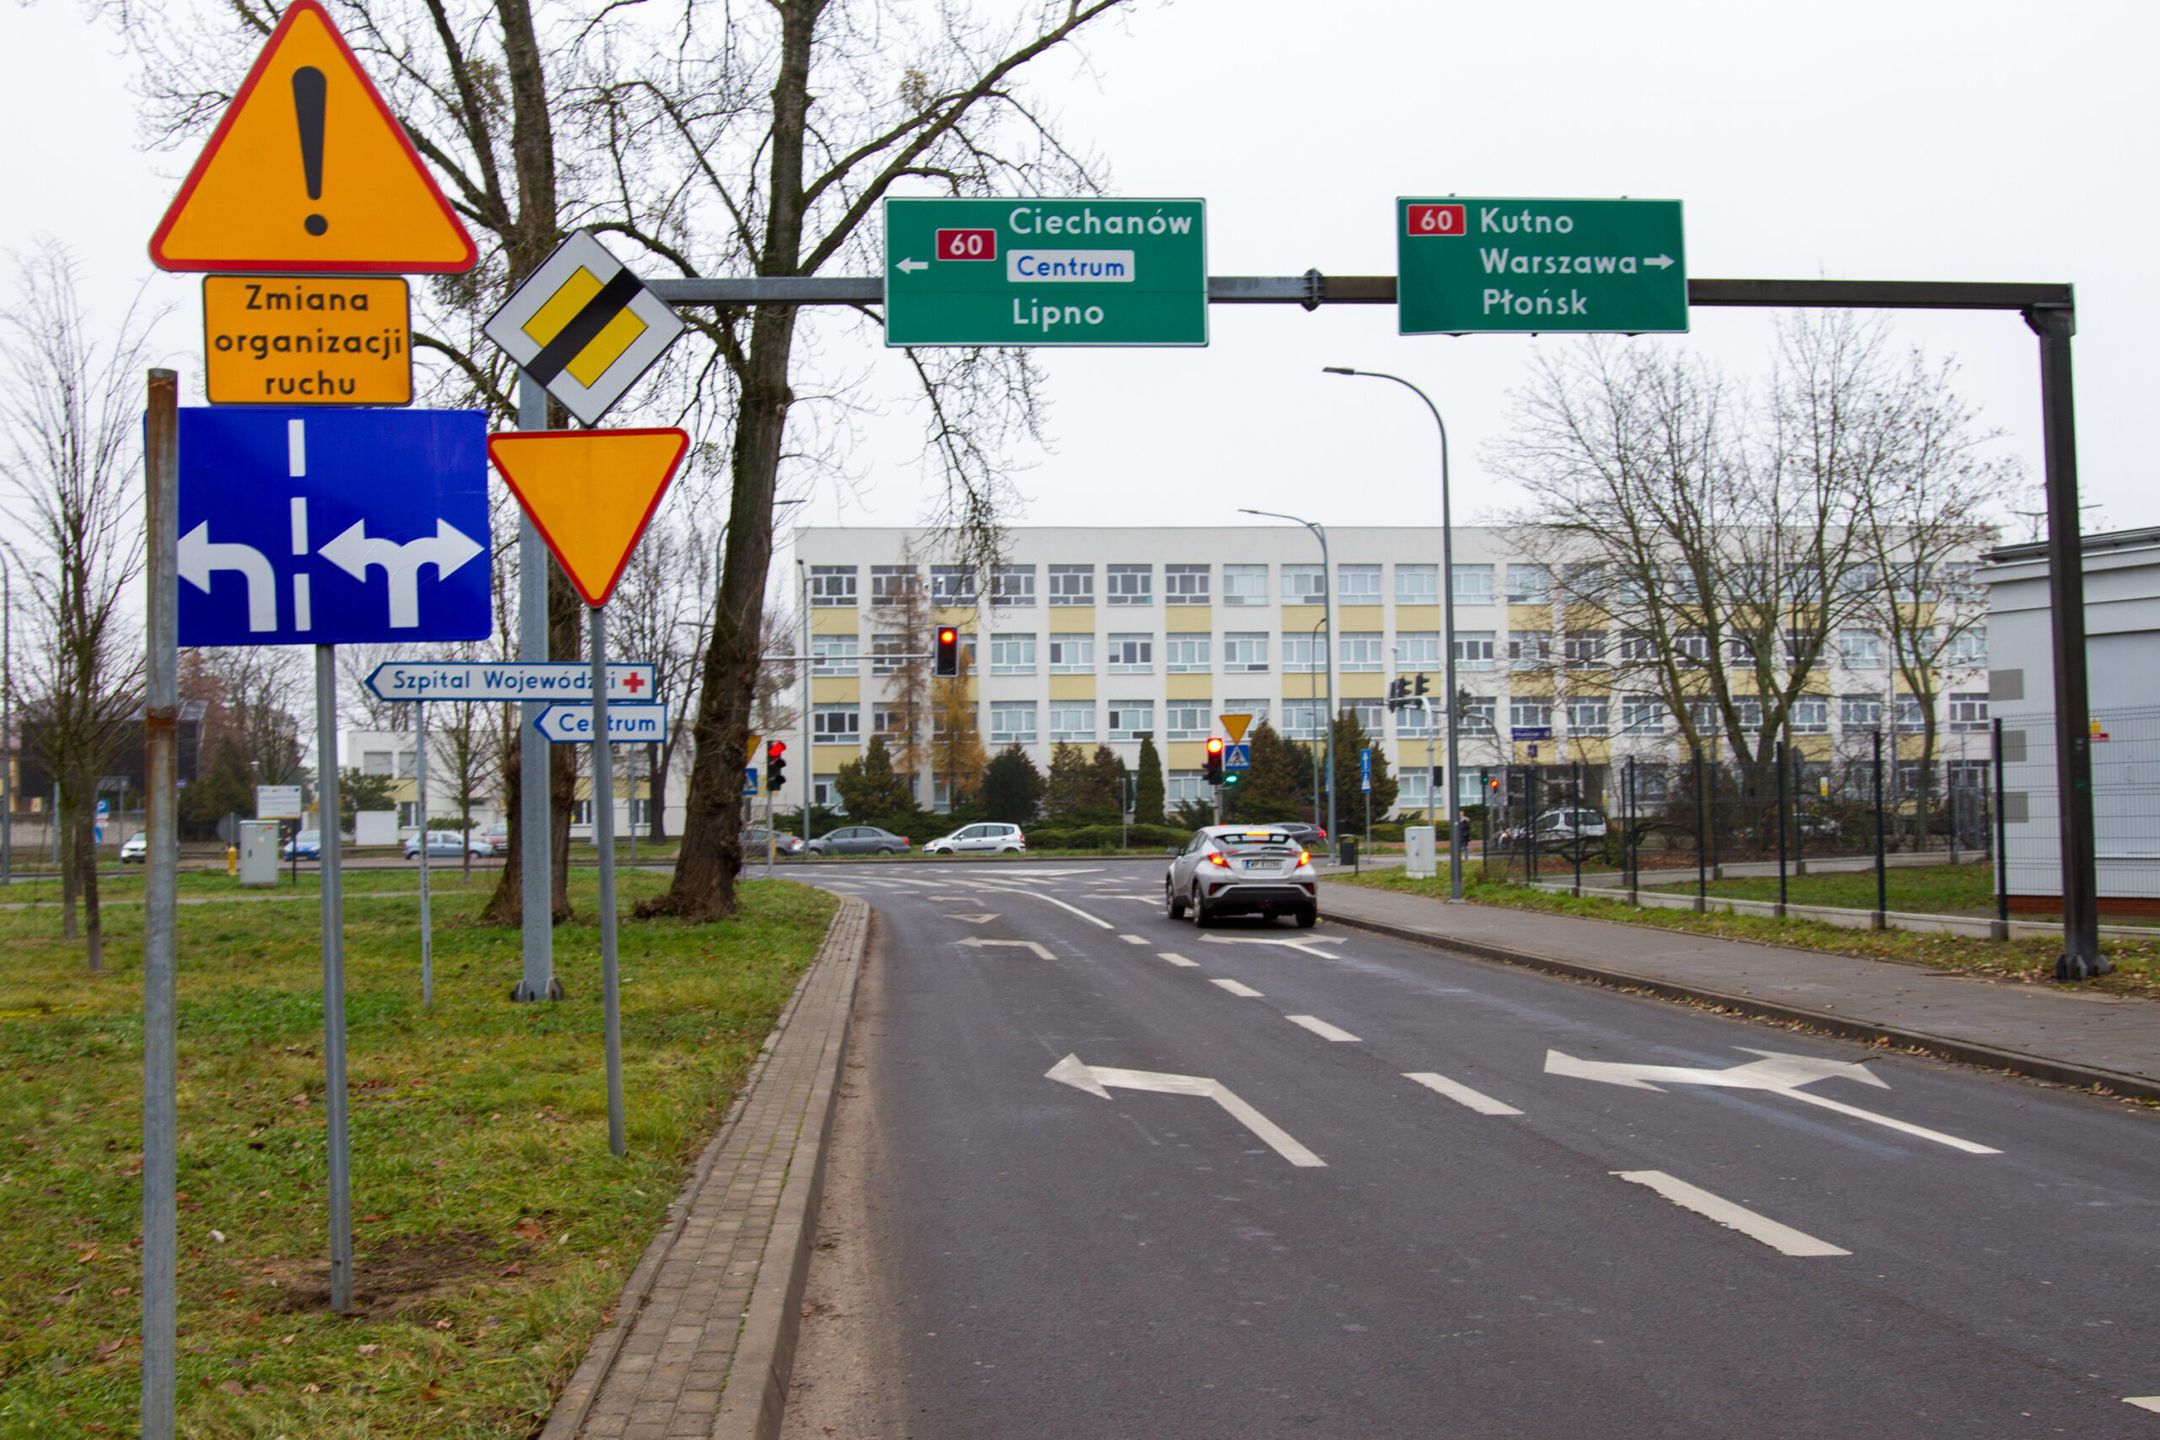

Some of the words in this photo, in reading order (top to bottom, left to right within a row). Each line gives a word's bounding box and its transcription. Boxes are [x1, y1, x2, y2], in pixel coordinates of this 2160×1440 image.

[1009, 207, 1192, 235] Ciechanów
[1420, 210, 1453, 231] 60
[1480, 208, 1574, 234] Kutno
[951, 234, 983, 256] 60
[1017, 256, 1125, 277] Centrum
[1479, 248, 1637, 274] Warszawa
[246, 284, 368, 311] Zmiana
[1483, 287, 1587, 315] Płońsk
[1013, 298, 1104, 332] Lipno
[215, 328, 401, 360] organizacji
[265, 370, 356, 395] ruchu
[393, 670, 470, 694] Szpital
[559, 713, 656, 732] Cetrum
